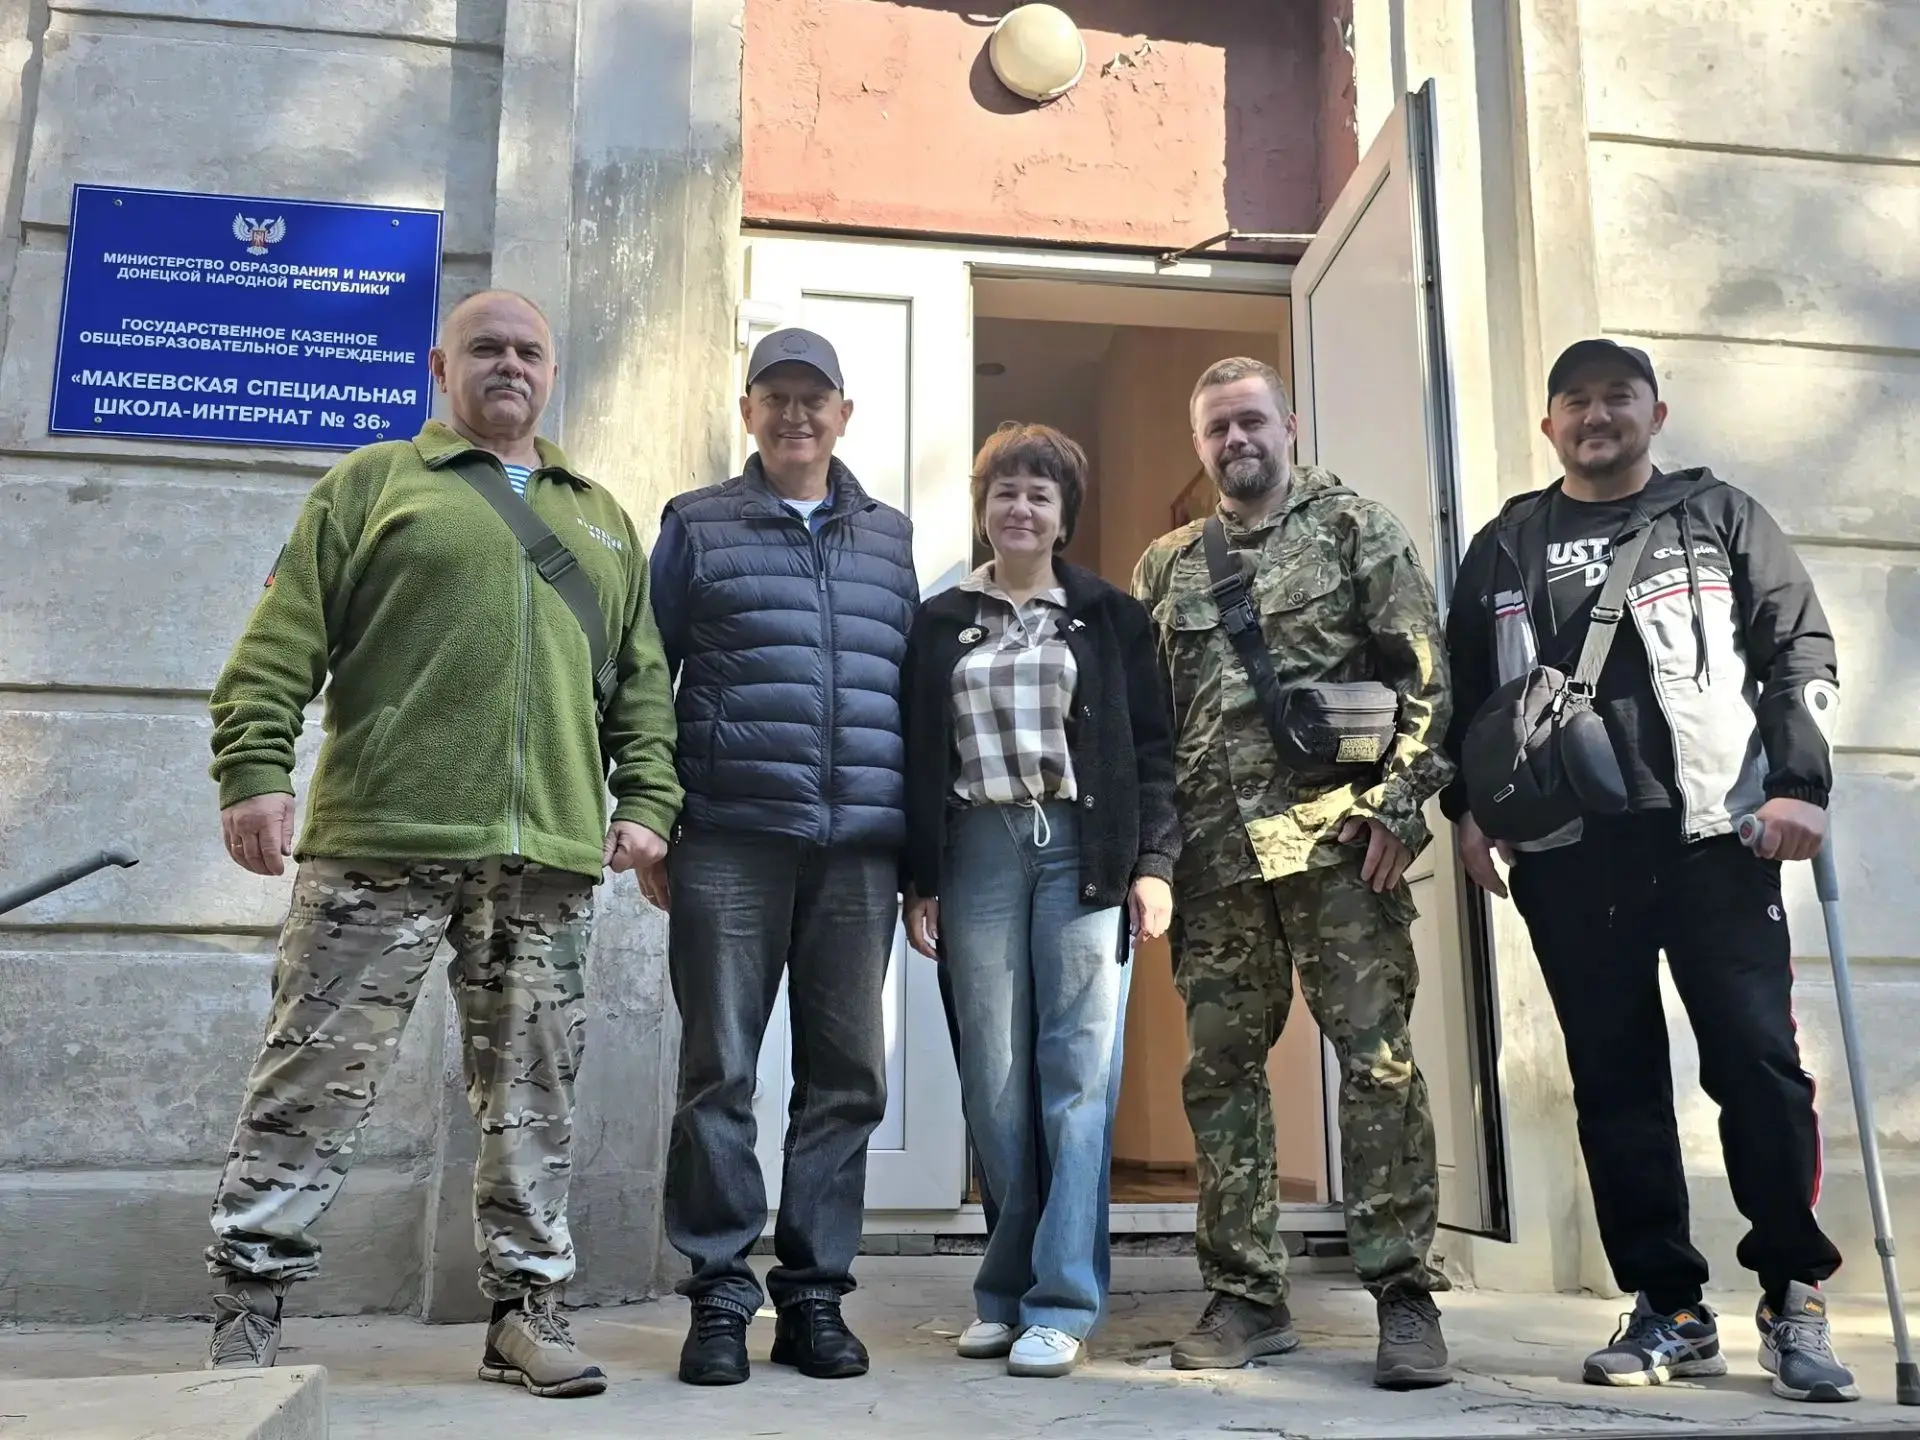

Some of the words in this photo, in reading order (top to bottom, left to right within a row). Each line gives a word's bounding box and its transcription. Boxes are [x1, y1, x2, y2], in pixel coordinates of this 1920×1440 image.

[103, 252, 224, 270] МИНИСТЕРСТВО
[229, 260, 338, 279] ОБРАЗОВАНИЯ
[343, 268, 354, 280] И
[359, 269, 406, 283] НАУКИ
[117, 267, 201, 282] ДОНЕЦКОЙ
[206, 273, 288, 289] НАРОДНОЙ
[293, 278, 390, 296] РЕСПУБЛИКИ
[79, 331, 299, 356] ОБЩЕОБРАЗОВАТЕЛЬНОЕ
[304, 345, 416, 364] УЧРЕЖДЕНИЕ
[121, 318, 286, 340] ГОСУДАРСТВЕННОЕ
[291, 329, 378, 346] КАЗЕННОЕ
[71, 369, 238, 394] «МАКЕЕВСКАЯ
[246, 379, 417, 405] СПЕЦИАЛЬНАЯ
[94, 397, 313, 426] ШКОЛА-ИНТЕРНАТ
[320, 411, 345, 428] №
[353, 413, 391, 430] 36»
